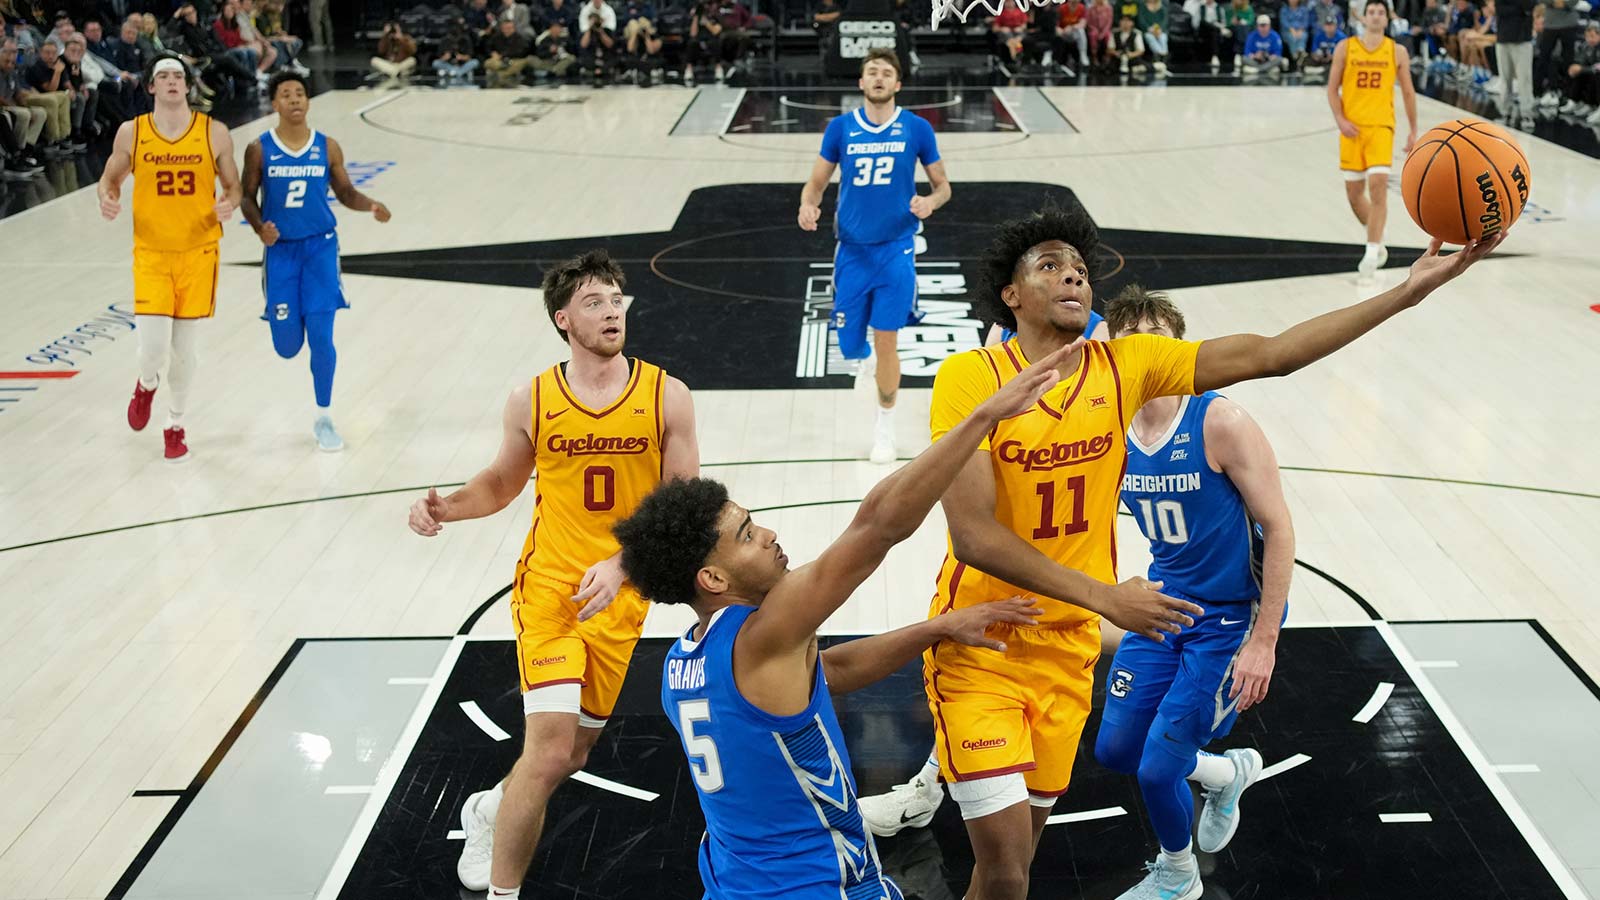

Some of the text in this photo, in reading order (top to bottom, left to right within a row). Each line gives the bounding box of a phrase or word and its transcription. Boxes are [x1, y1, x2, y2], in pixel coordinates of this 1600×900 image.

[839, 21, 896, 33] GEICO
[1357, 72, 1381, 88] 22
[143, 152, 203, 165] Cyclones
[847, 142, 906, 155] CREIGHTON
[156, 171, 196, 195] 23
[268, 166, 326, 177] CREIGHTON
[853, 156, 895, 186] 32
[285, 180, 307, 208] 2
[547, 433, 649, 457] Cyclones
[999, 431, 1113, 473] Cyclones
[584, 466, 615, 511] 0
[1121, 472, 1201, 493] REIGHTON
[1032, 475, 1089, 540] 11
[1136, 499, 1189, 544] 10
[677, 698, 725, 793] 5
[961, 738, 1007, 751] Cyclones
